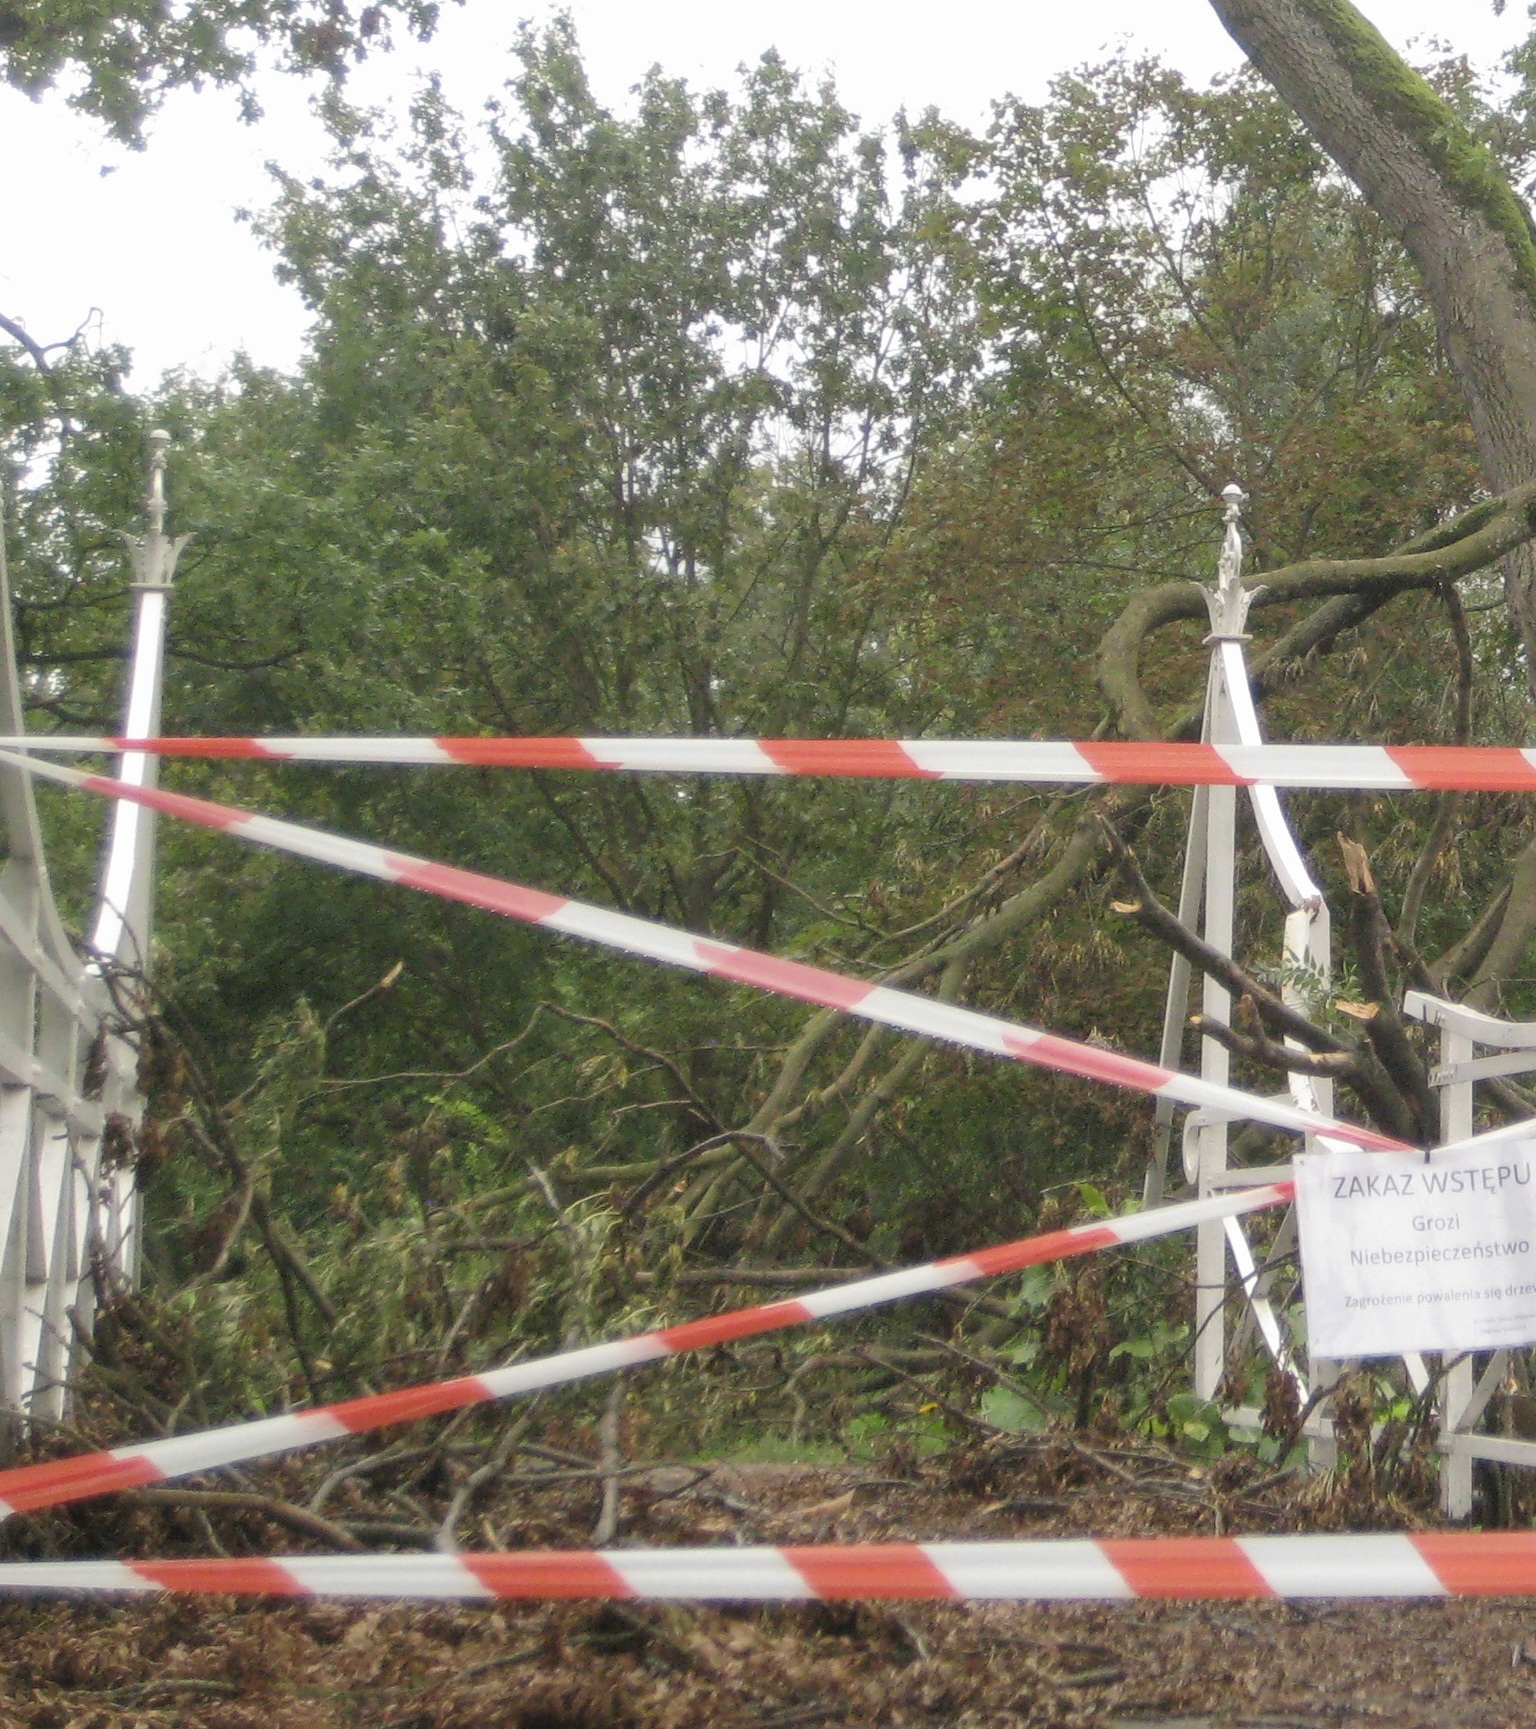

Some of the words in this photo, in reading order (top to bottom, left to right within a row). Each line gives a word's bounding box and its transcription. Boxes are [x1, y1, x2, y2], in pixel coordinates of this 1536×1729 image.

[1333, 1174, 1414, 1199] ZAKAZ
[1422, 1162, 1531, 1195] WSTĘPU
[1412, 1213, 1460, 1232] Grozi
[1350, 1239, 1530, 1267] Niebezpieczeństwo
[1344, 1293, 1413, 1309] Zagrożenie
[1417, 1289, 1481, 1306] powalenia
[1483, 1286, 1502, 1301] się
